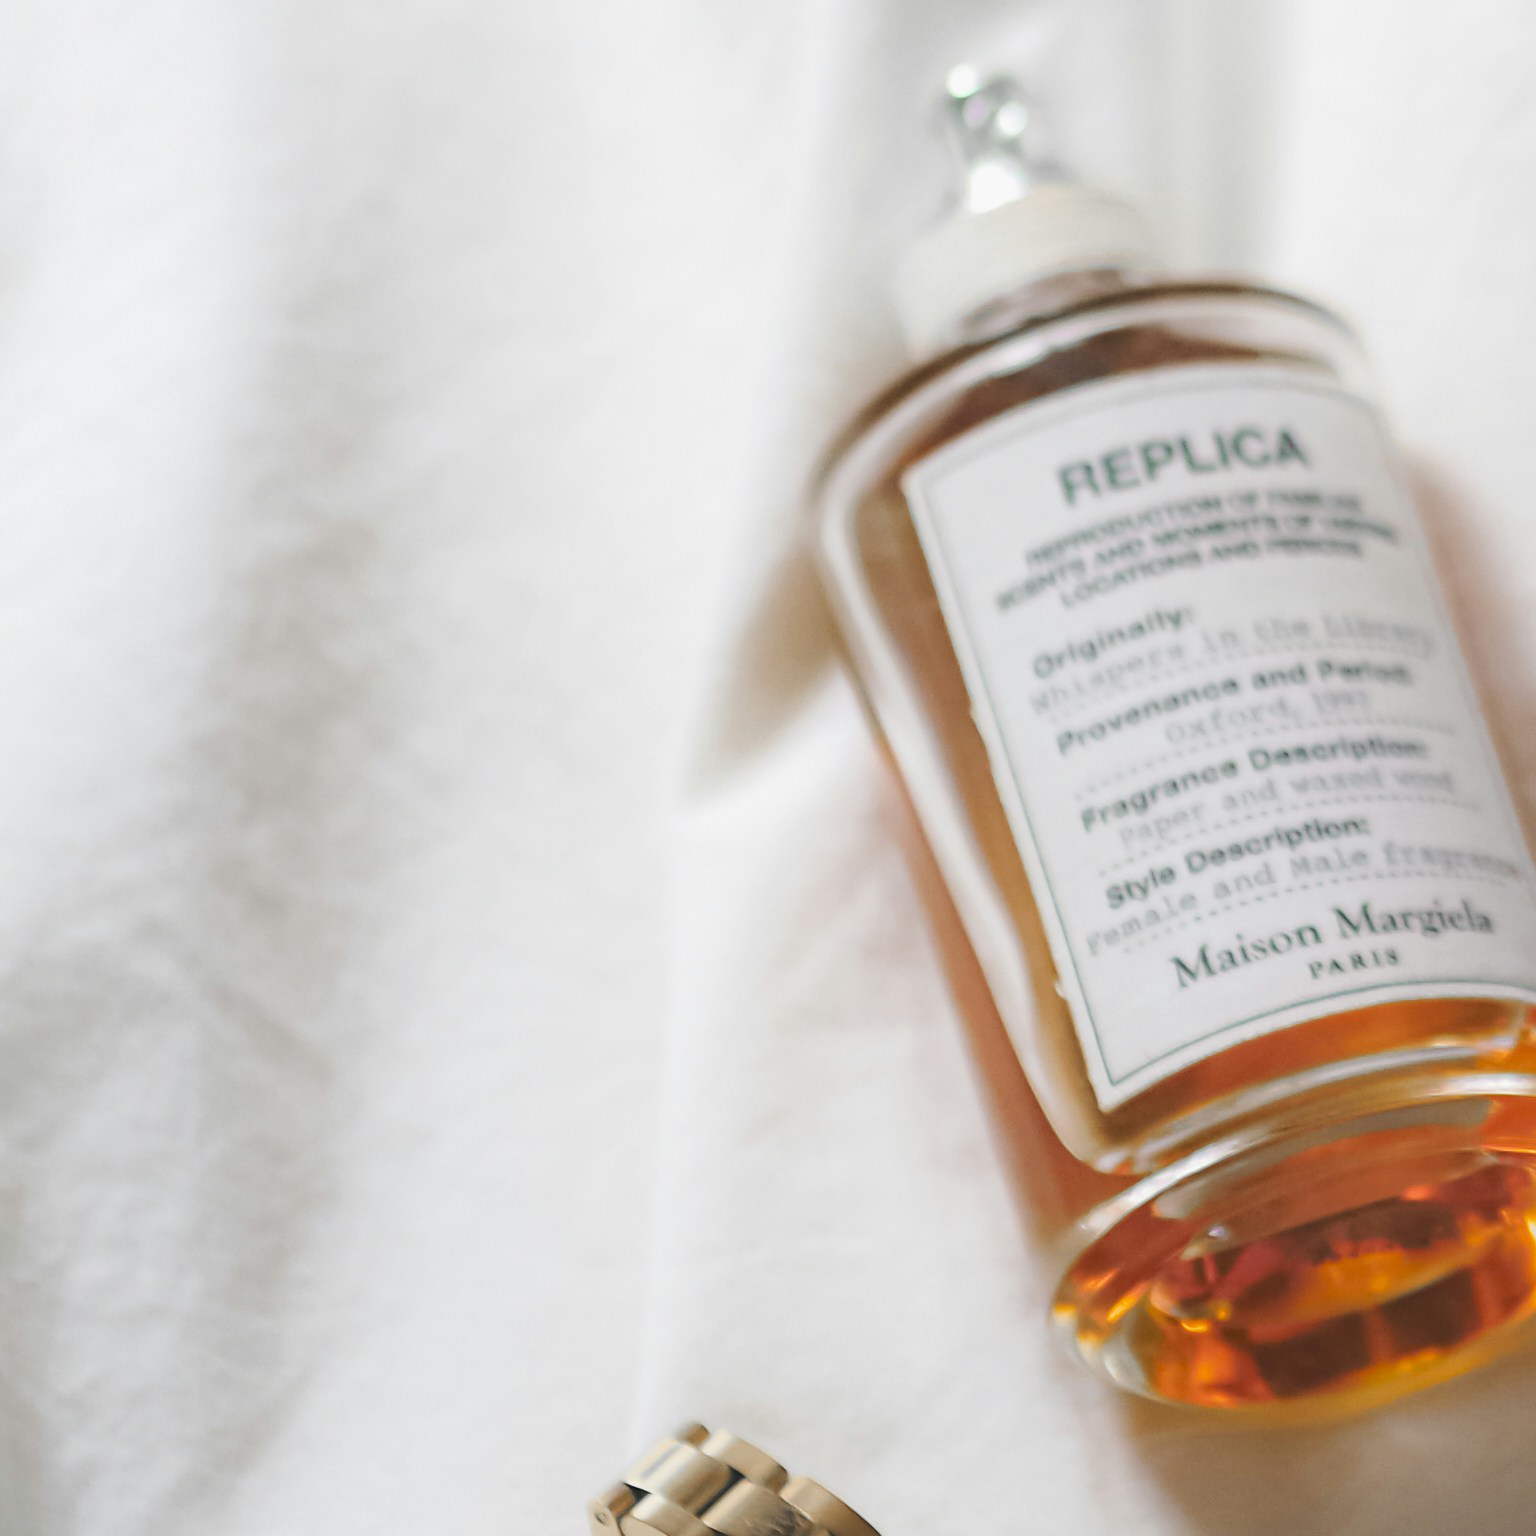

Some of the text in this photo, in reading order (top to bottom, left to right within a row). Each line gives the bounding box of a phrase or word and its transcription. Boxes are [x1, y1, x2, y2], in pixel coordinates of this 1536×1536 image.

[1058, 429, 1310, 507] REPLICA
[1032, 604, 1194, 680] Originally:
[1056, 674, 1241, 756] Provenance
[1251, 660, 1307, 689] and
[1081, 736, 1428, 833] Fragrance Description:
[1220, 780, 1279, 813] and
[1085, 890, 1199, 957] Female
[1212, 861, 1278, 901] and
[1290, 846, 1370, 880] Male
[1105, 815, 1373, 911] Style Description:
[1167, 892, 1497, 990] Maison Margiela
[1308, 947, 1402, 981] PARIS
